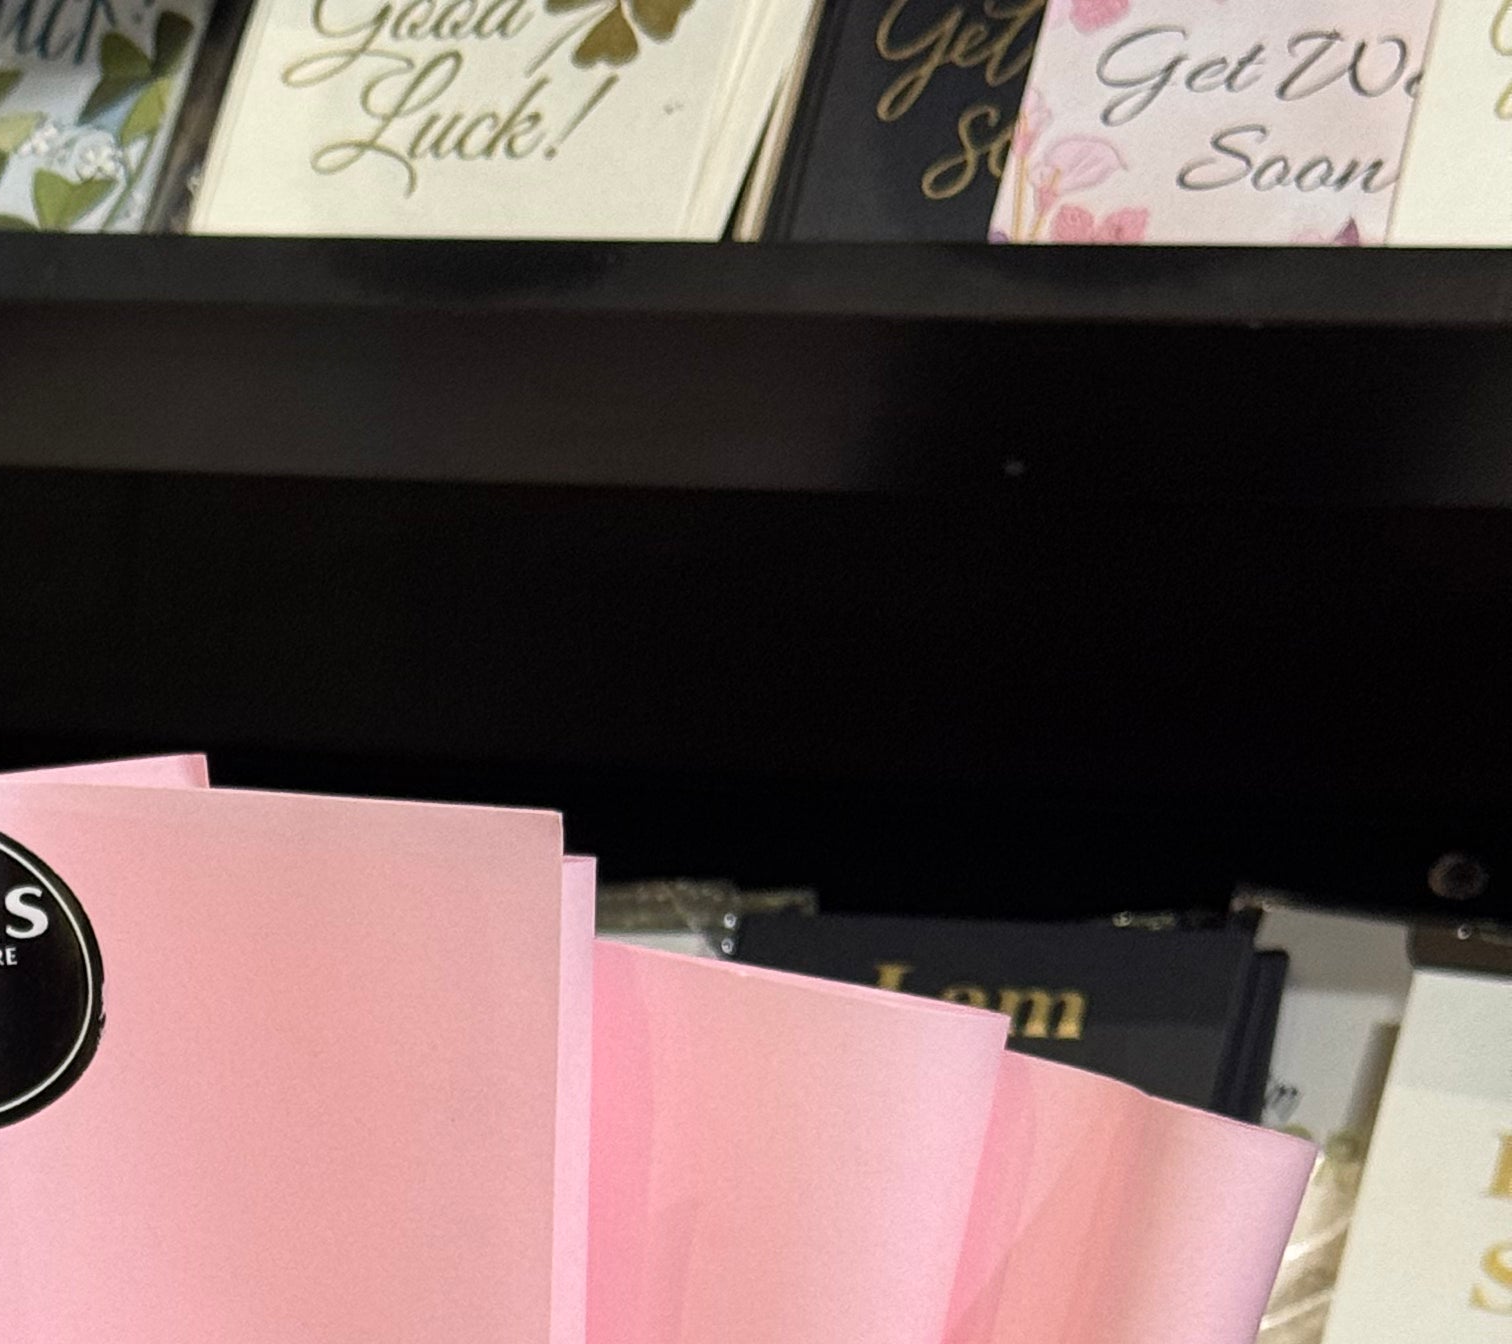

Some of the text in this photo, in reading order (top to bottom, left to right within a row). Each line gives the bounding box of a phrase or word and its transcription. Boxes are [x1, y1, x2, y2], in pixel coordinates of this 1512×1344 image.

[310, 49, 619, 199] Luck!
[1095, 24, 1265, 127] Get
[1175, 124, 1400, 195] Soon
